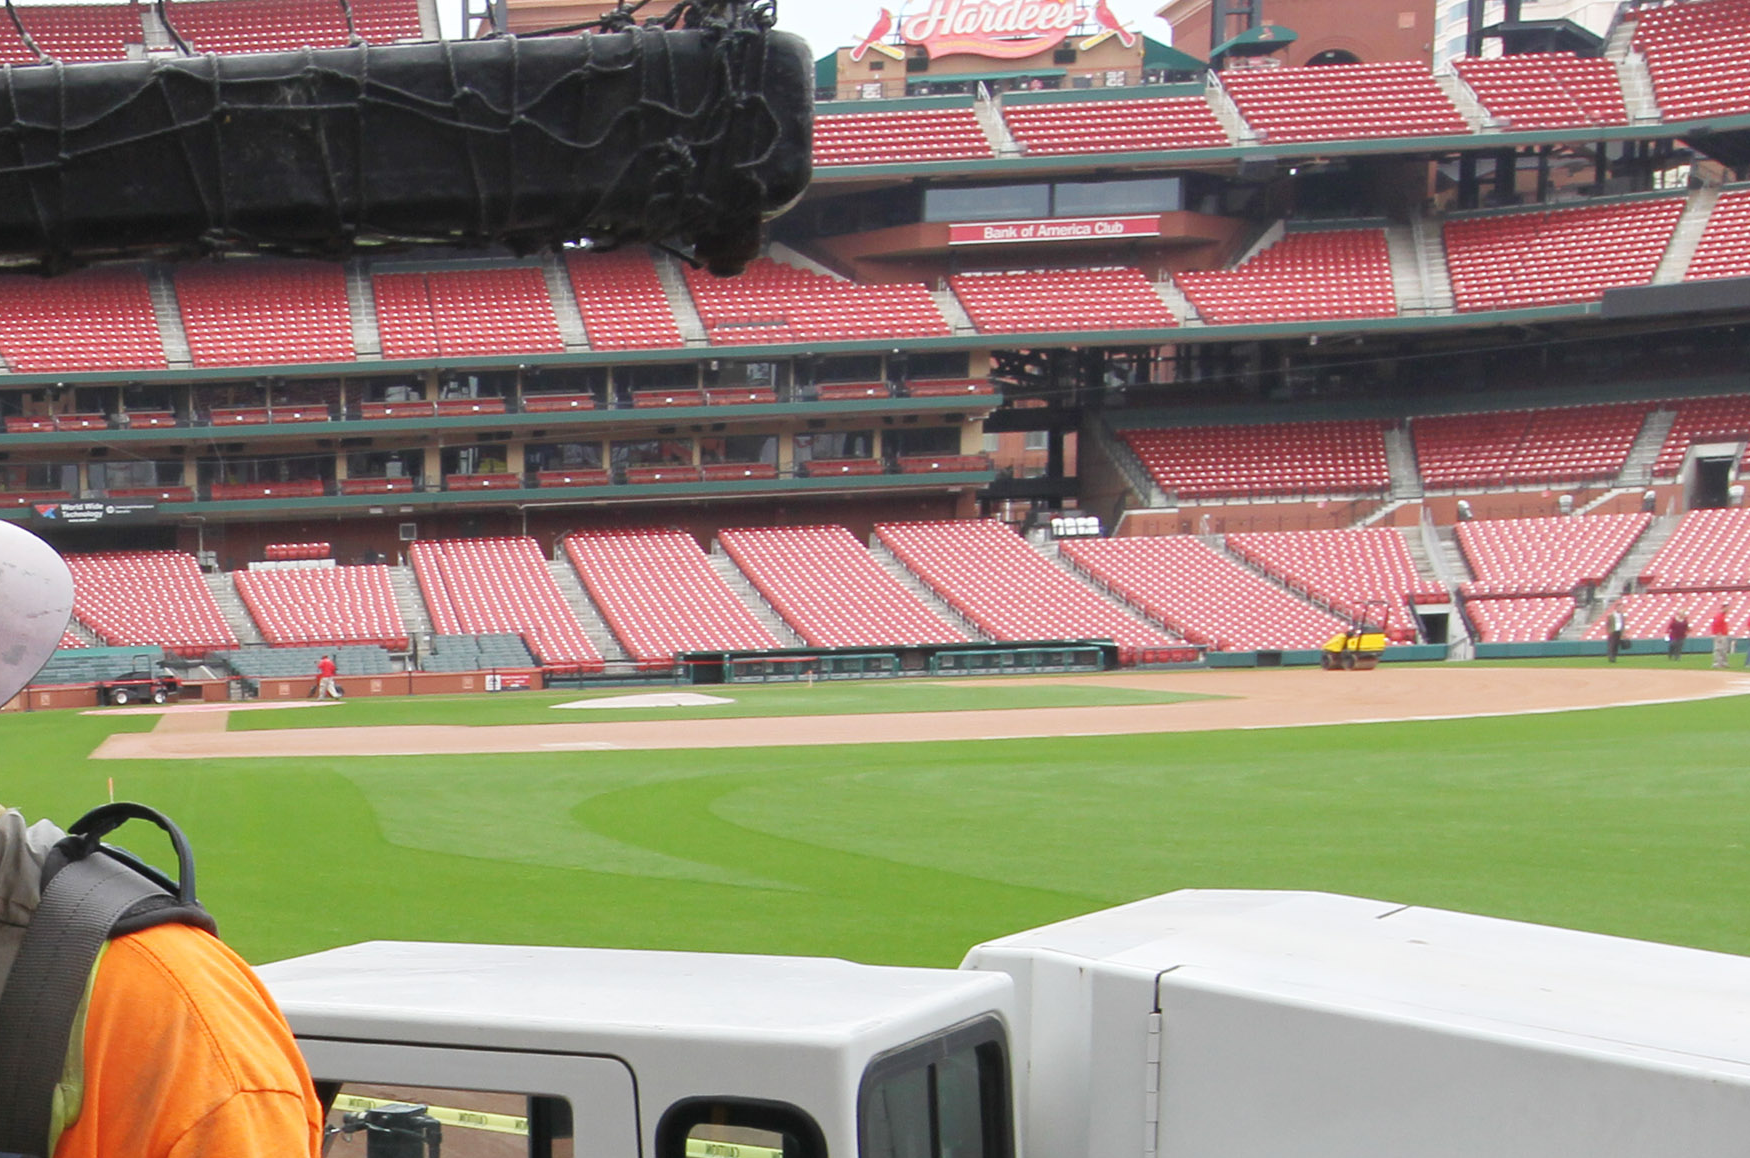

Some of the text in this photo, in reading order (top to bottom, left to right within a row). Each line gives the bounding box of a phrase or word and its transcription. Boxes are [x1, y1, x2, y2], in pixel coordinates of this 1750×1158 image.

[983, 221, 1124, 240] Bank of America Club
[60, 503, 84, 511] World
[61, 510, 104, 519] Technology
